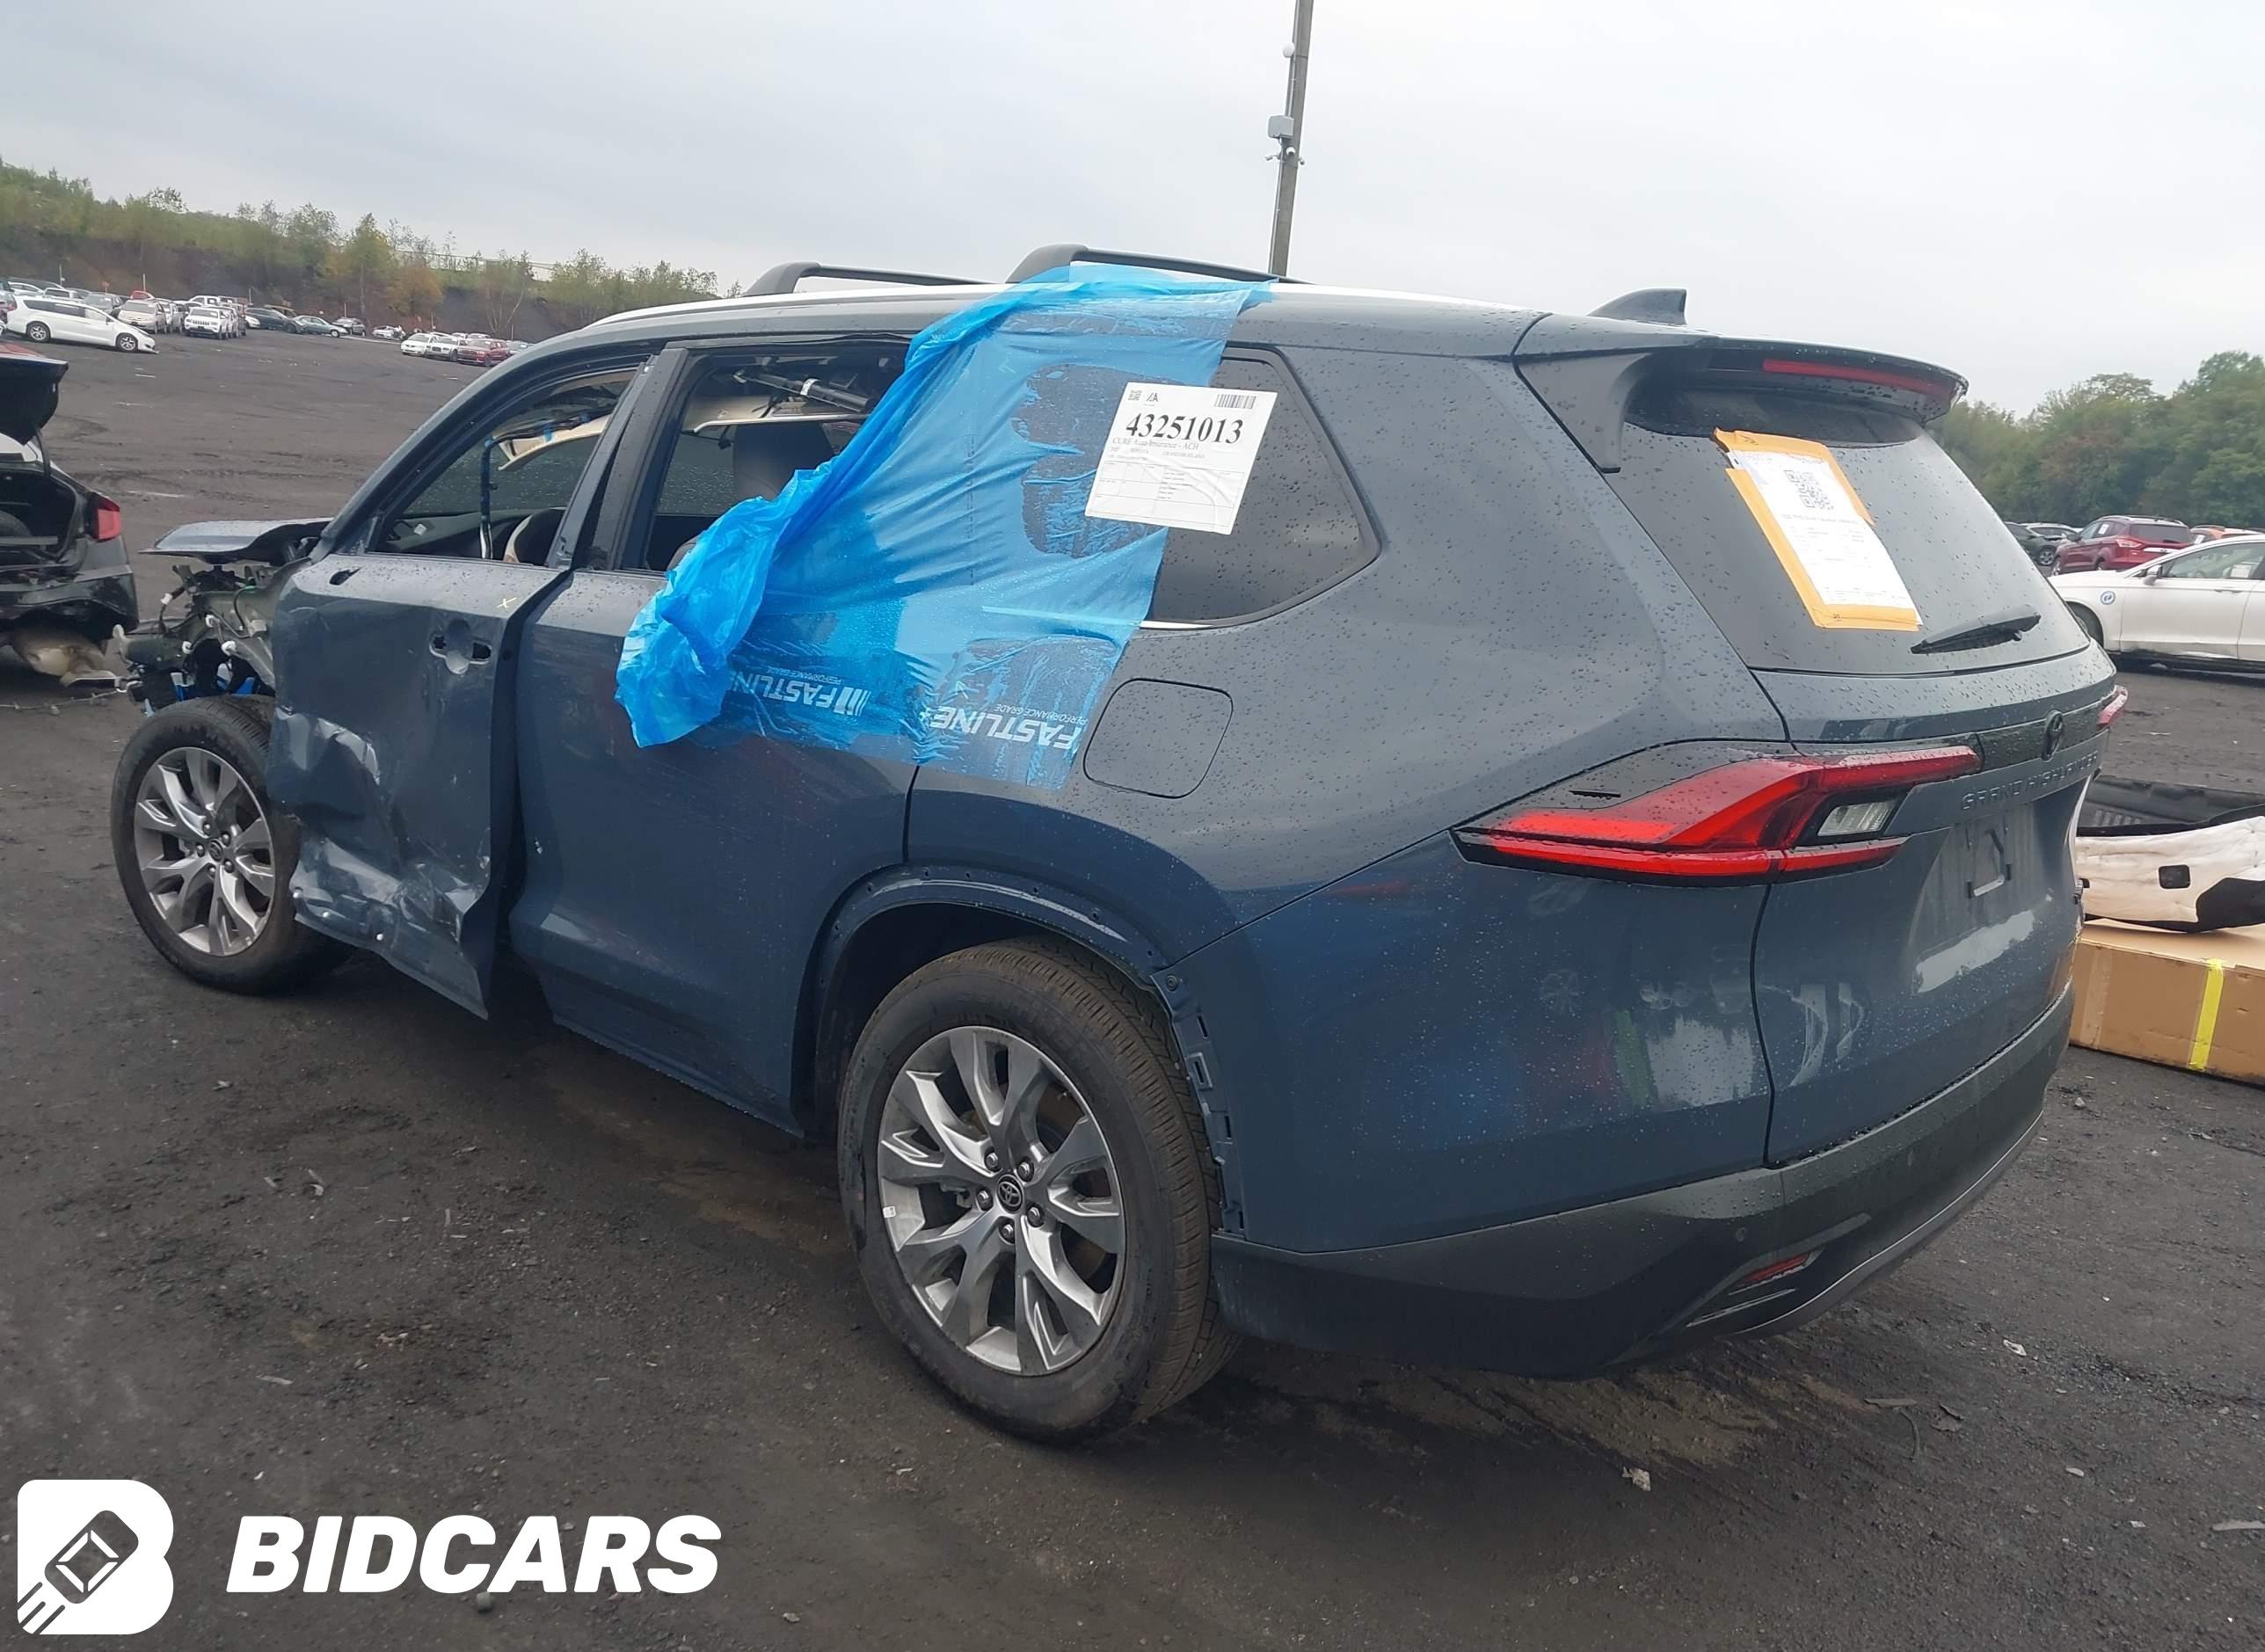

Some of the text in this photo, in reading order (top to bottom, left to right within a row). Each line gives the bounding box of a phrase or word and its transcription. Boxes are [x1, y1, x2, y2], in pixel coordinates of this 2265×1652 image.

[1125, 412, 1243, 444] 43251013
[1182, 441, 1199, 450] ACH
[730, 671, 838, 709] FASTLIN
[994, 704, 1089, 725] PERFORMANCE GRADE
[1961, 779, 2024, 811] GRAND
